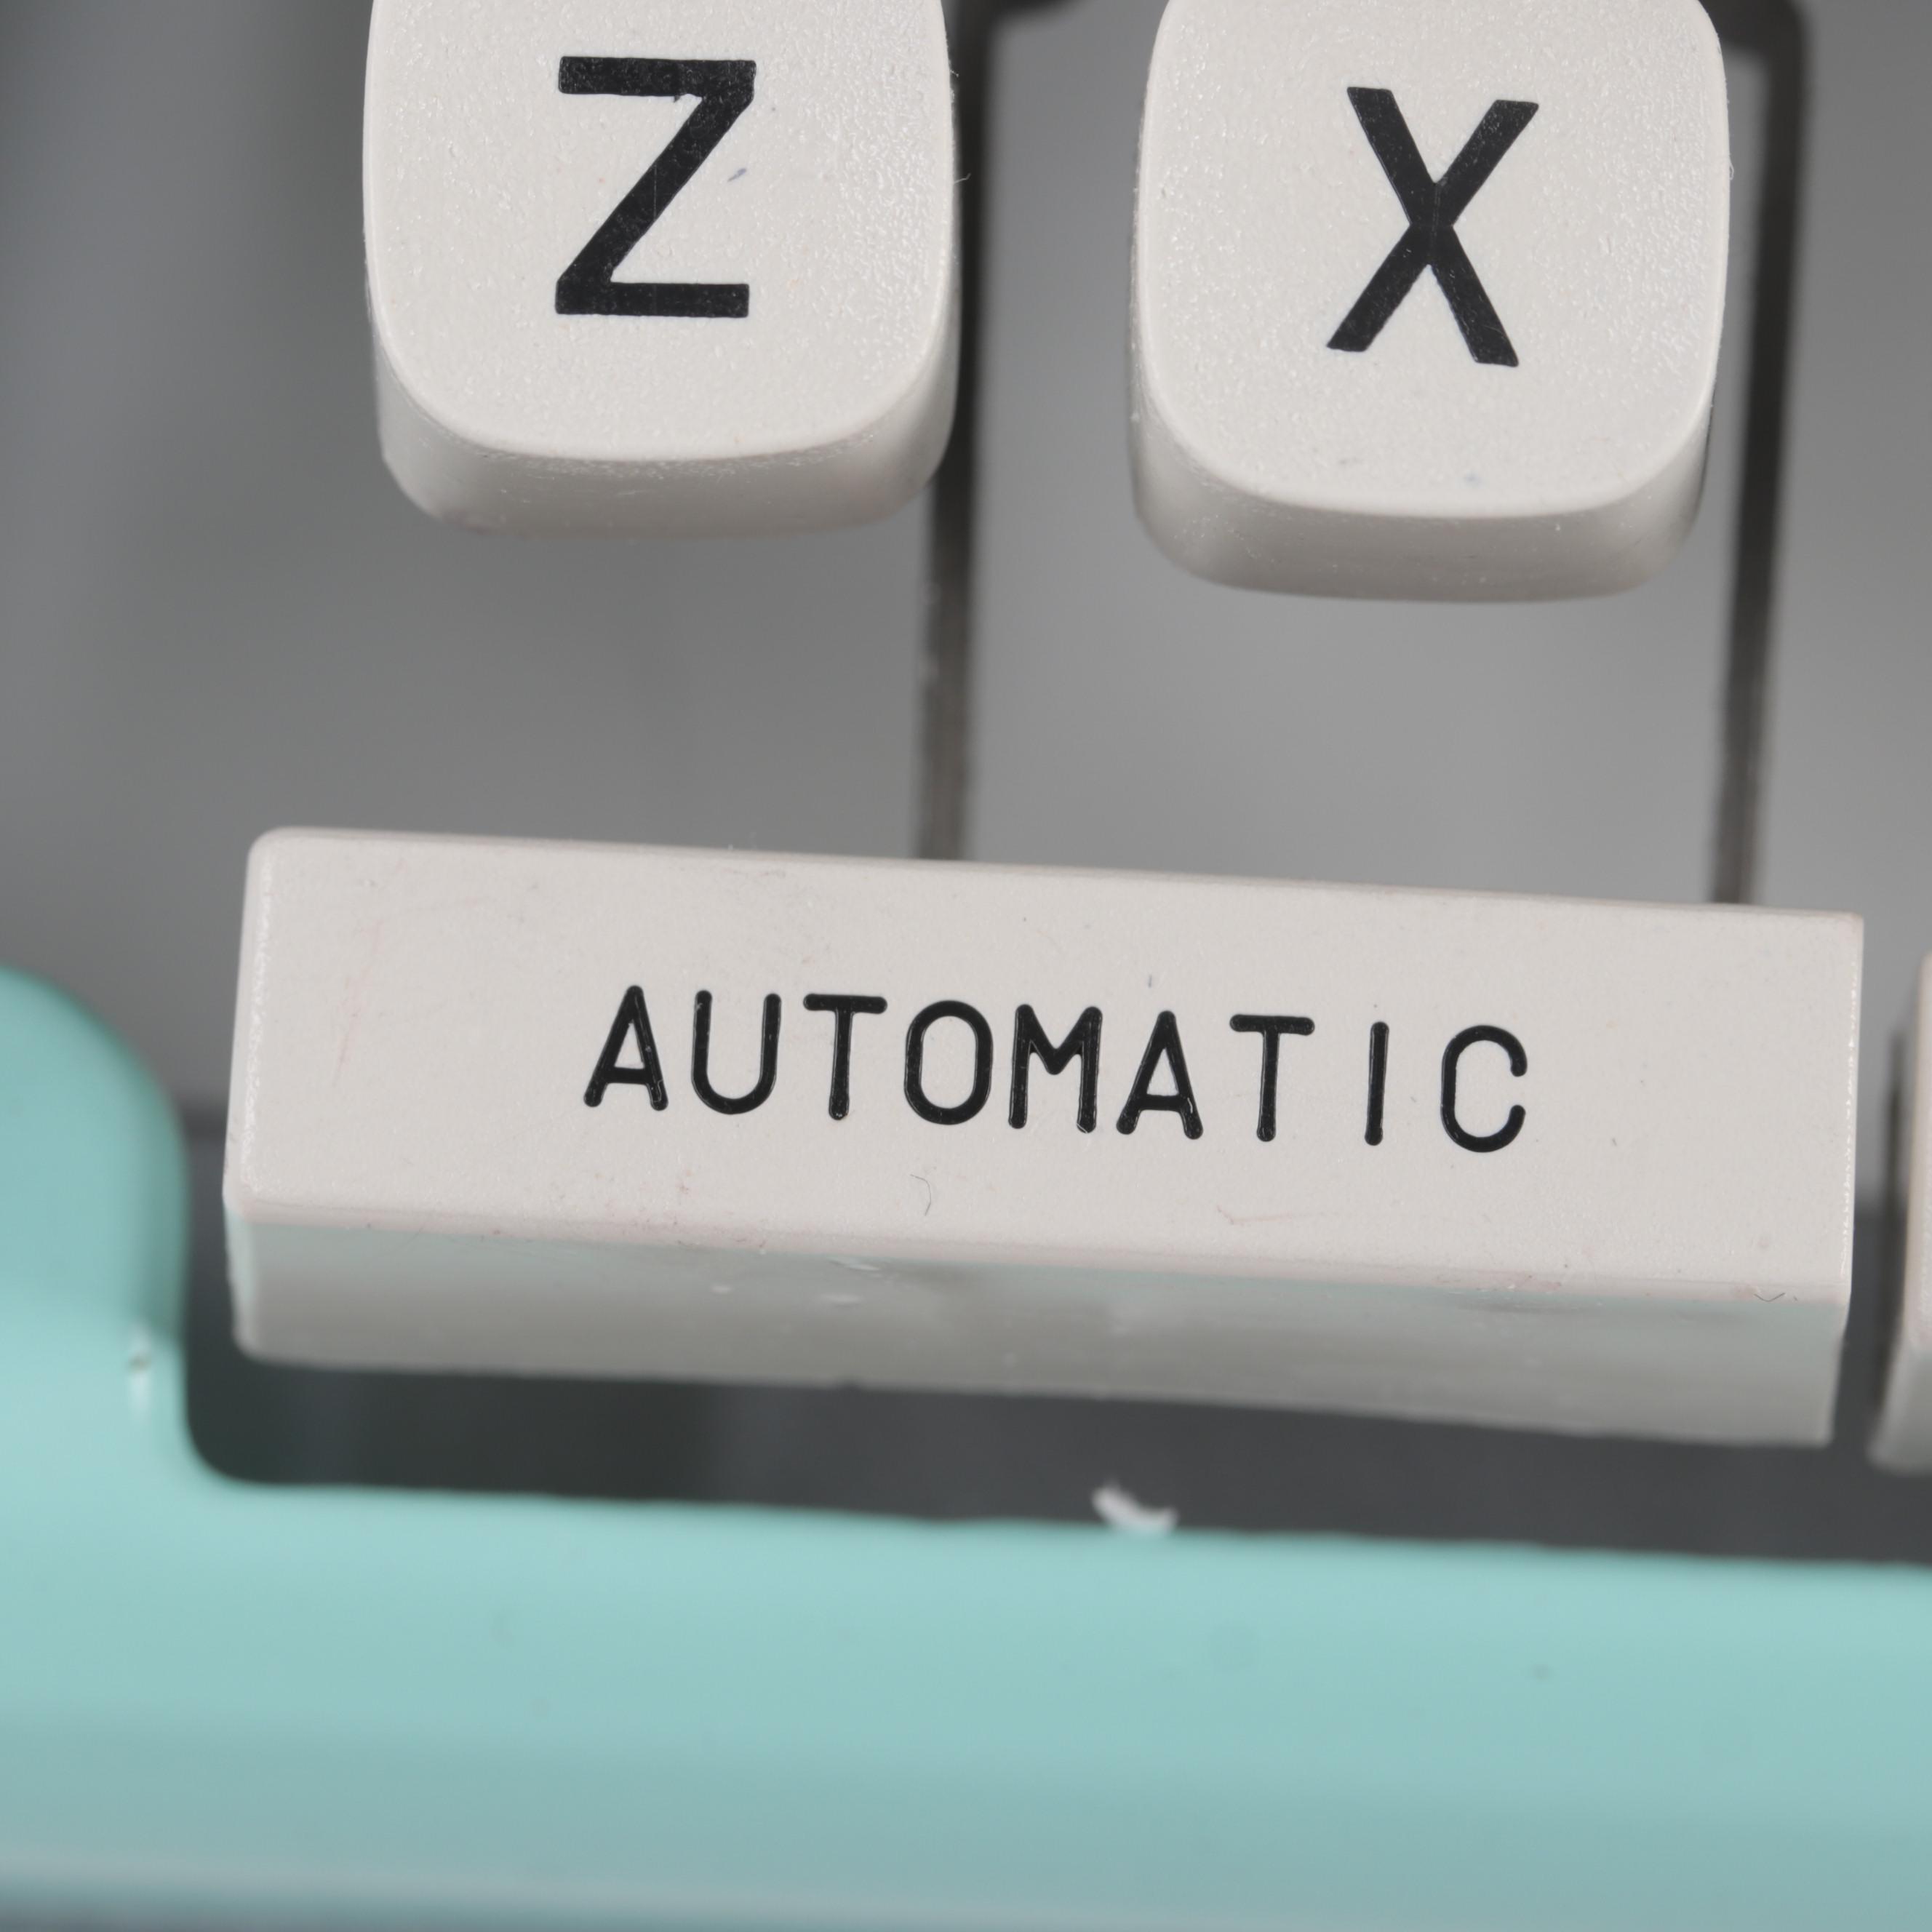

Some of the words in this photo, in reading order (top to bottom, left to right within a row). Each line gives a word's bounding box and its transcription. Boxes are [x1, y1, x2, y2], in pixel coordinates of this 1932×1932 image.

[555, 56, 757, 319] Z
[1327, 87, 1539, 367] X
[583, 985, 1528, 1154] AUTOMATIC
